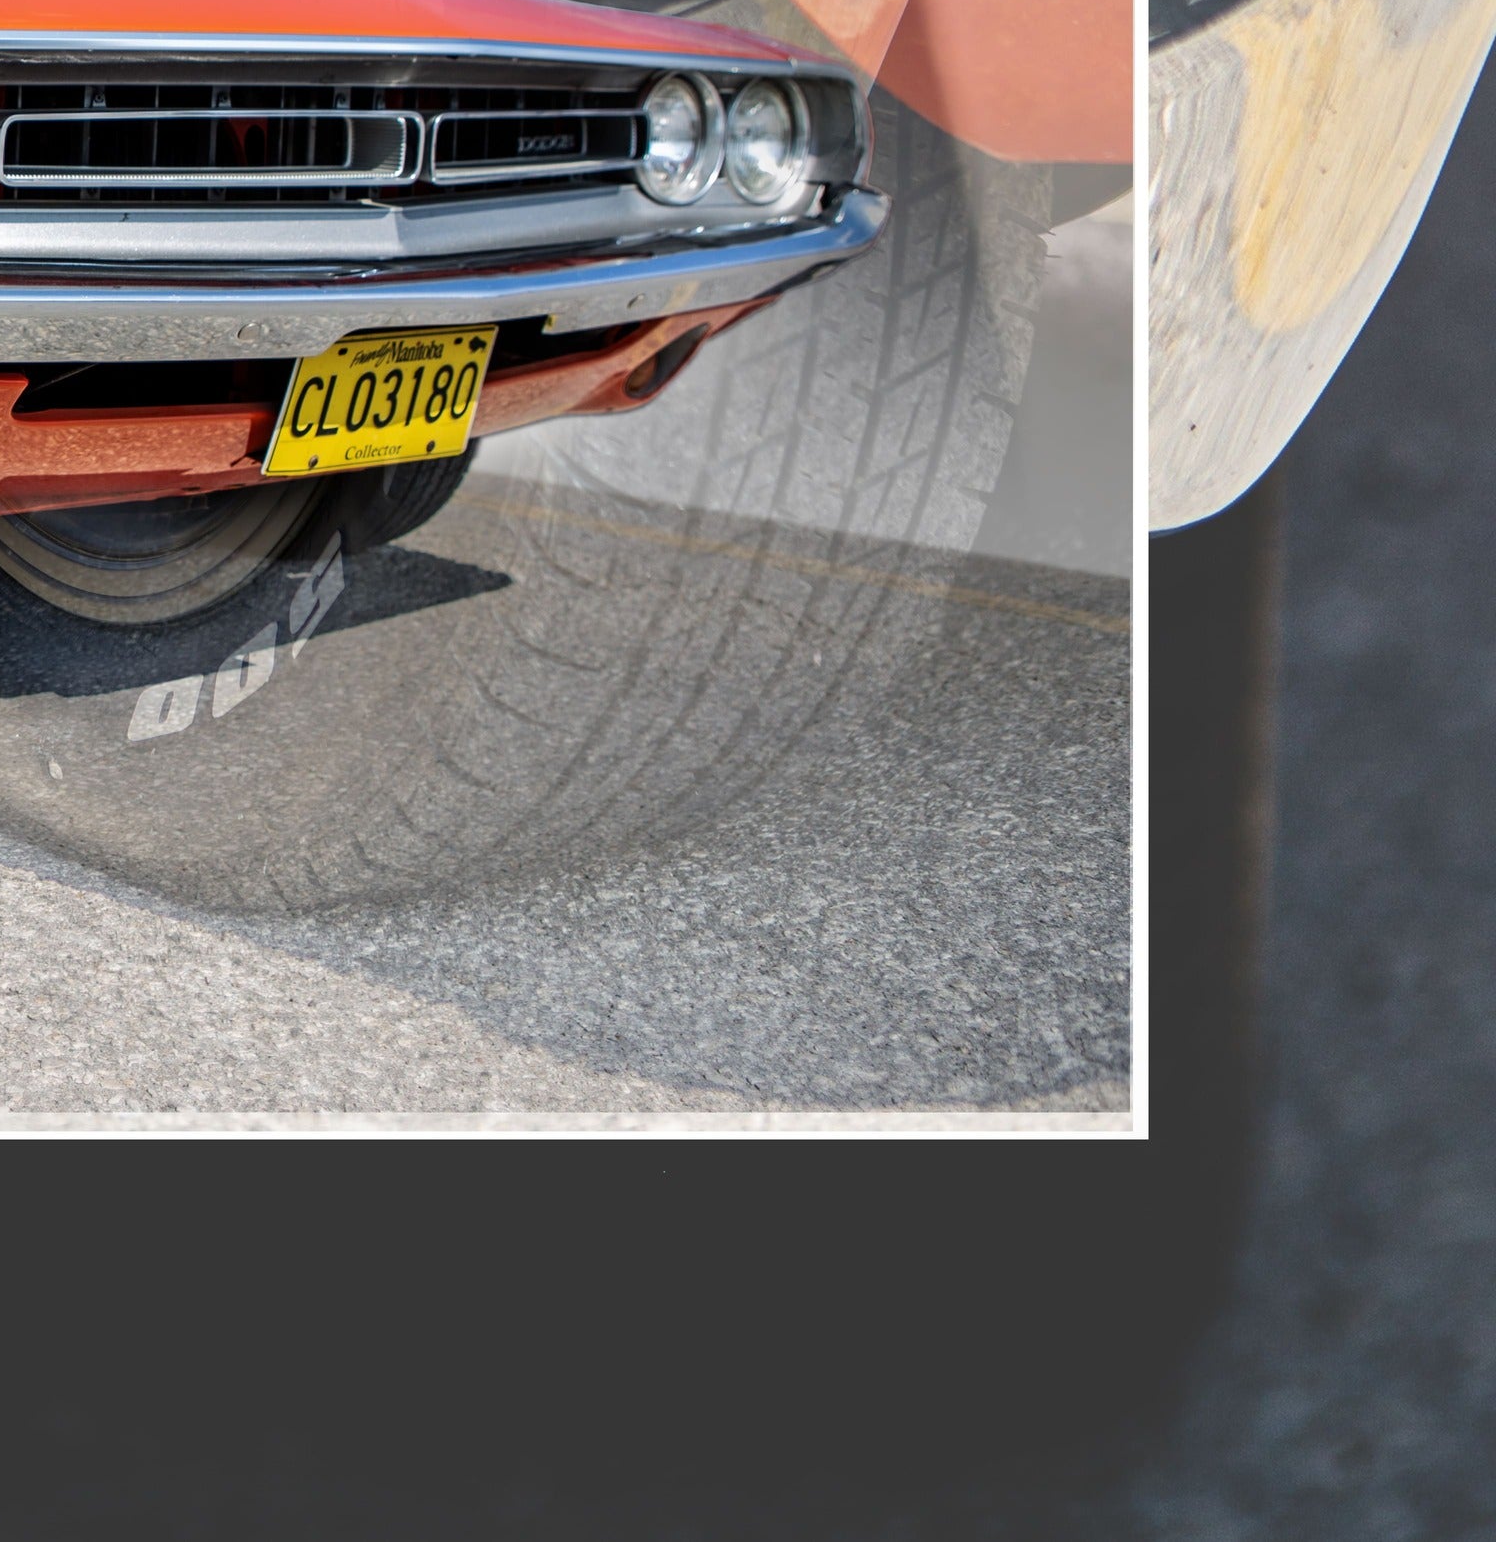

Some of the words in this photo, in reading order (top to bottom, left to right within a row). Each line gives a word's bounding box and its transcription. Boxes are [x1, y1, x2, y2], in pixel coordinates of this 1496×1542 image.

[390, 341, 444, 363] Manitoba
[291, 362, 479, 438] CL03180
[345, 445, 402, 461] Collector
